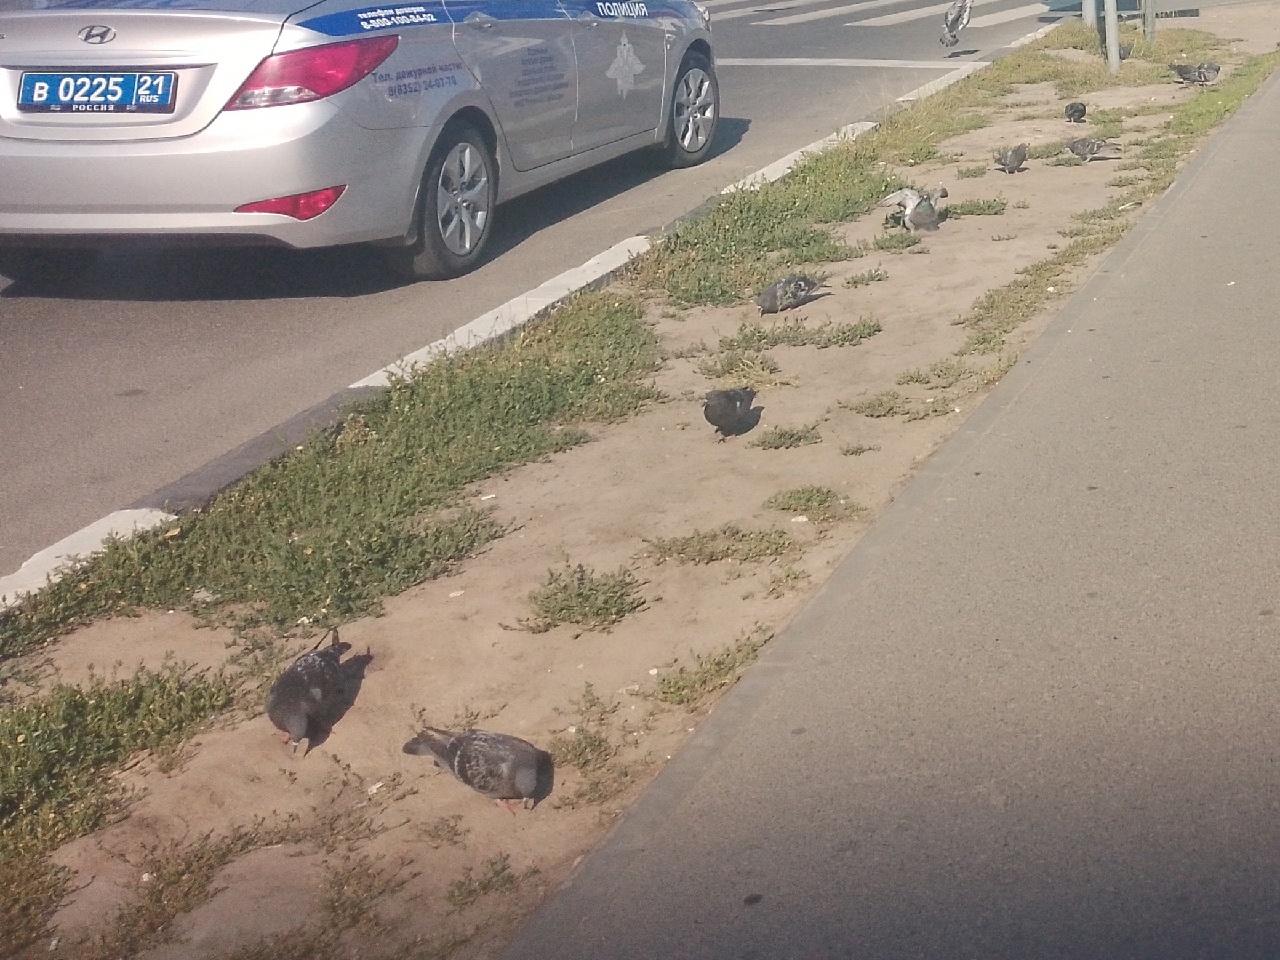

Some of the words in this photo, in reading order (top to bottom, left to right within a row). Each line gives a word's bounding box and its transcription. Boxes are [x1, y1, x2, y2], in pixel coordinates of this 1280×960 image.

[596, 2, 648, 18] ПОЛИЦИЯ
[33, 82, 49, 102] В
[58, 77, 124, 102] 0225
[138, 75, 163, 95] 21
[139, 95, 159, 103] RUS
